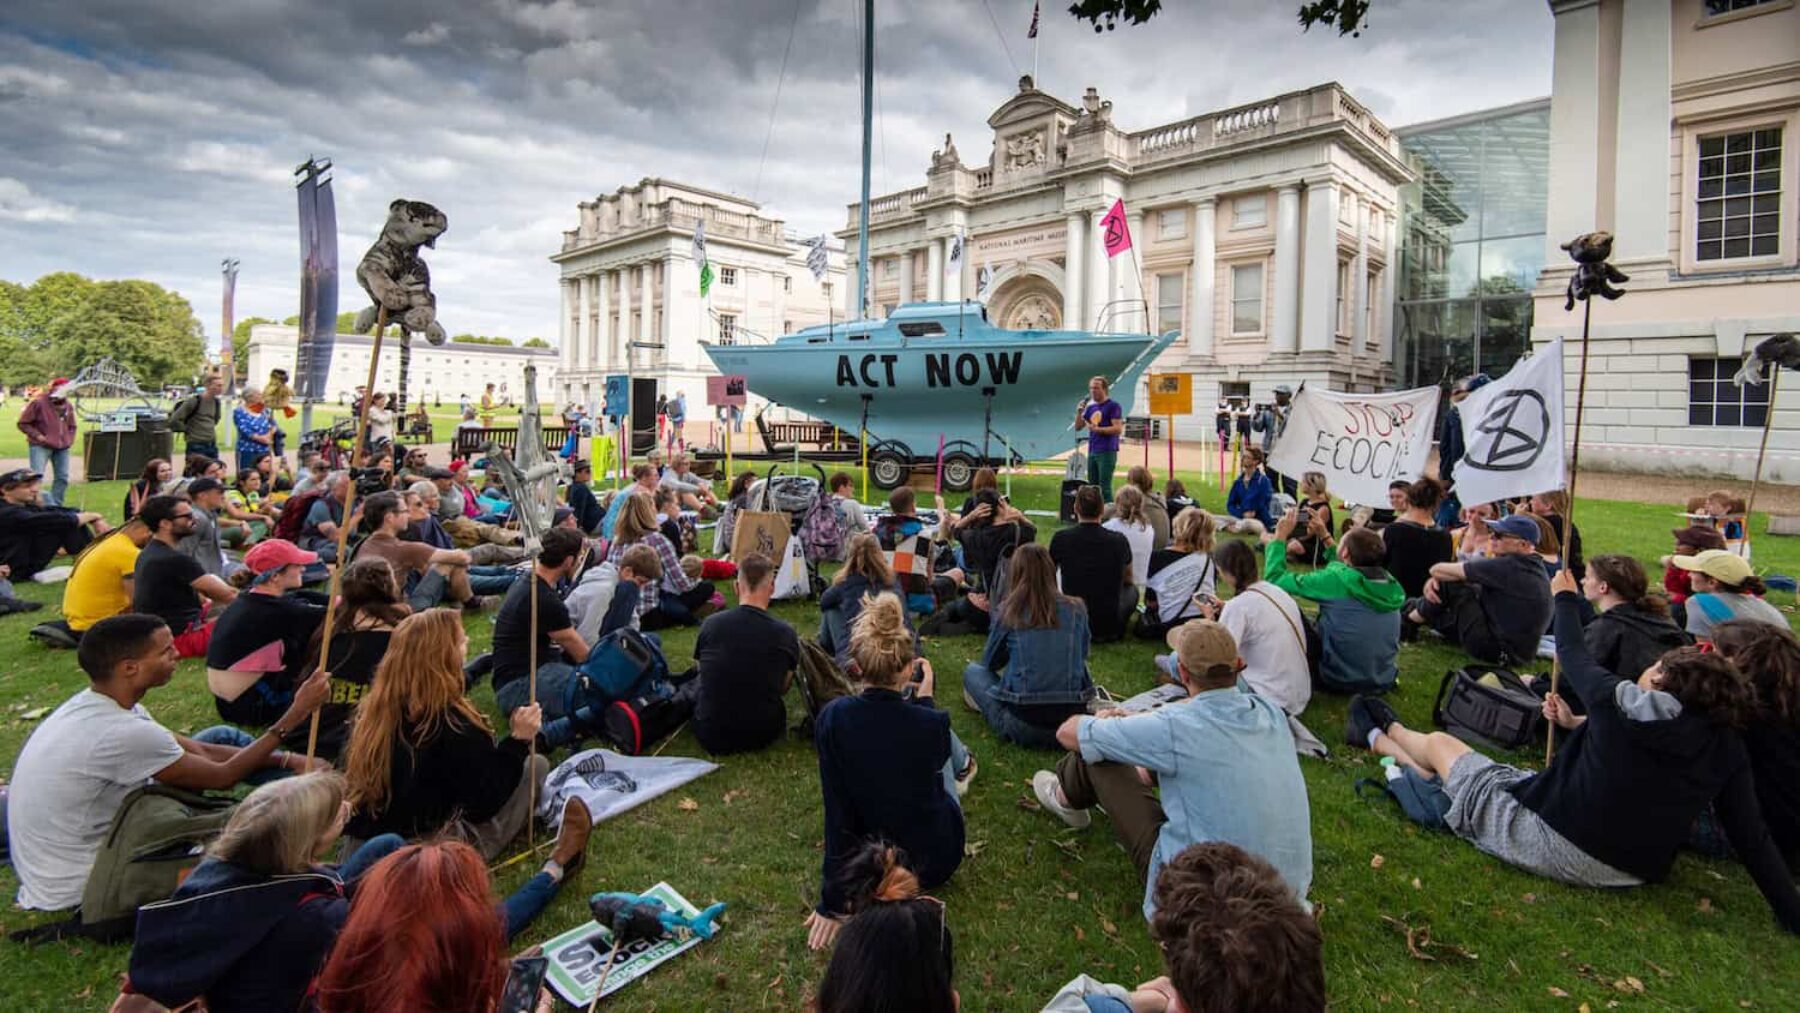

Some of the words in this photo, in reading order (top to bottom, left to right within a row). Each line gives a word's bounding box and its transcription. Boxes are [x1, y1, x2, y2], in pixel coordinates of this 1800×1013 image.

[979, 239, 1011, 250] NATIONAL
[1013, 234, 1044, 245] MARITIME
[836, 354, 898, 387] ACT
[925, 351, 1023, 387] NOW
